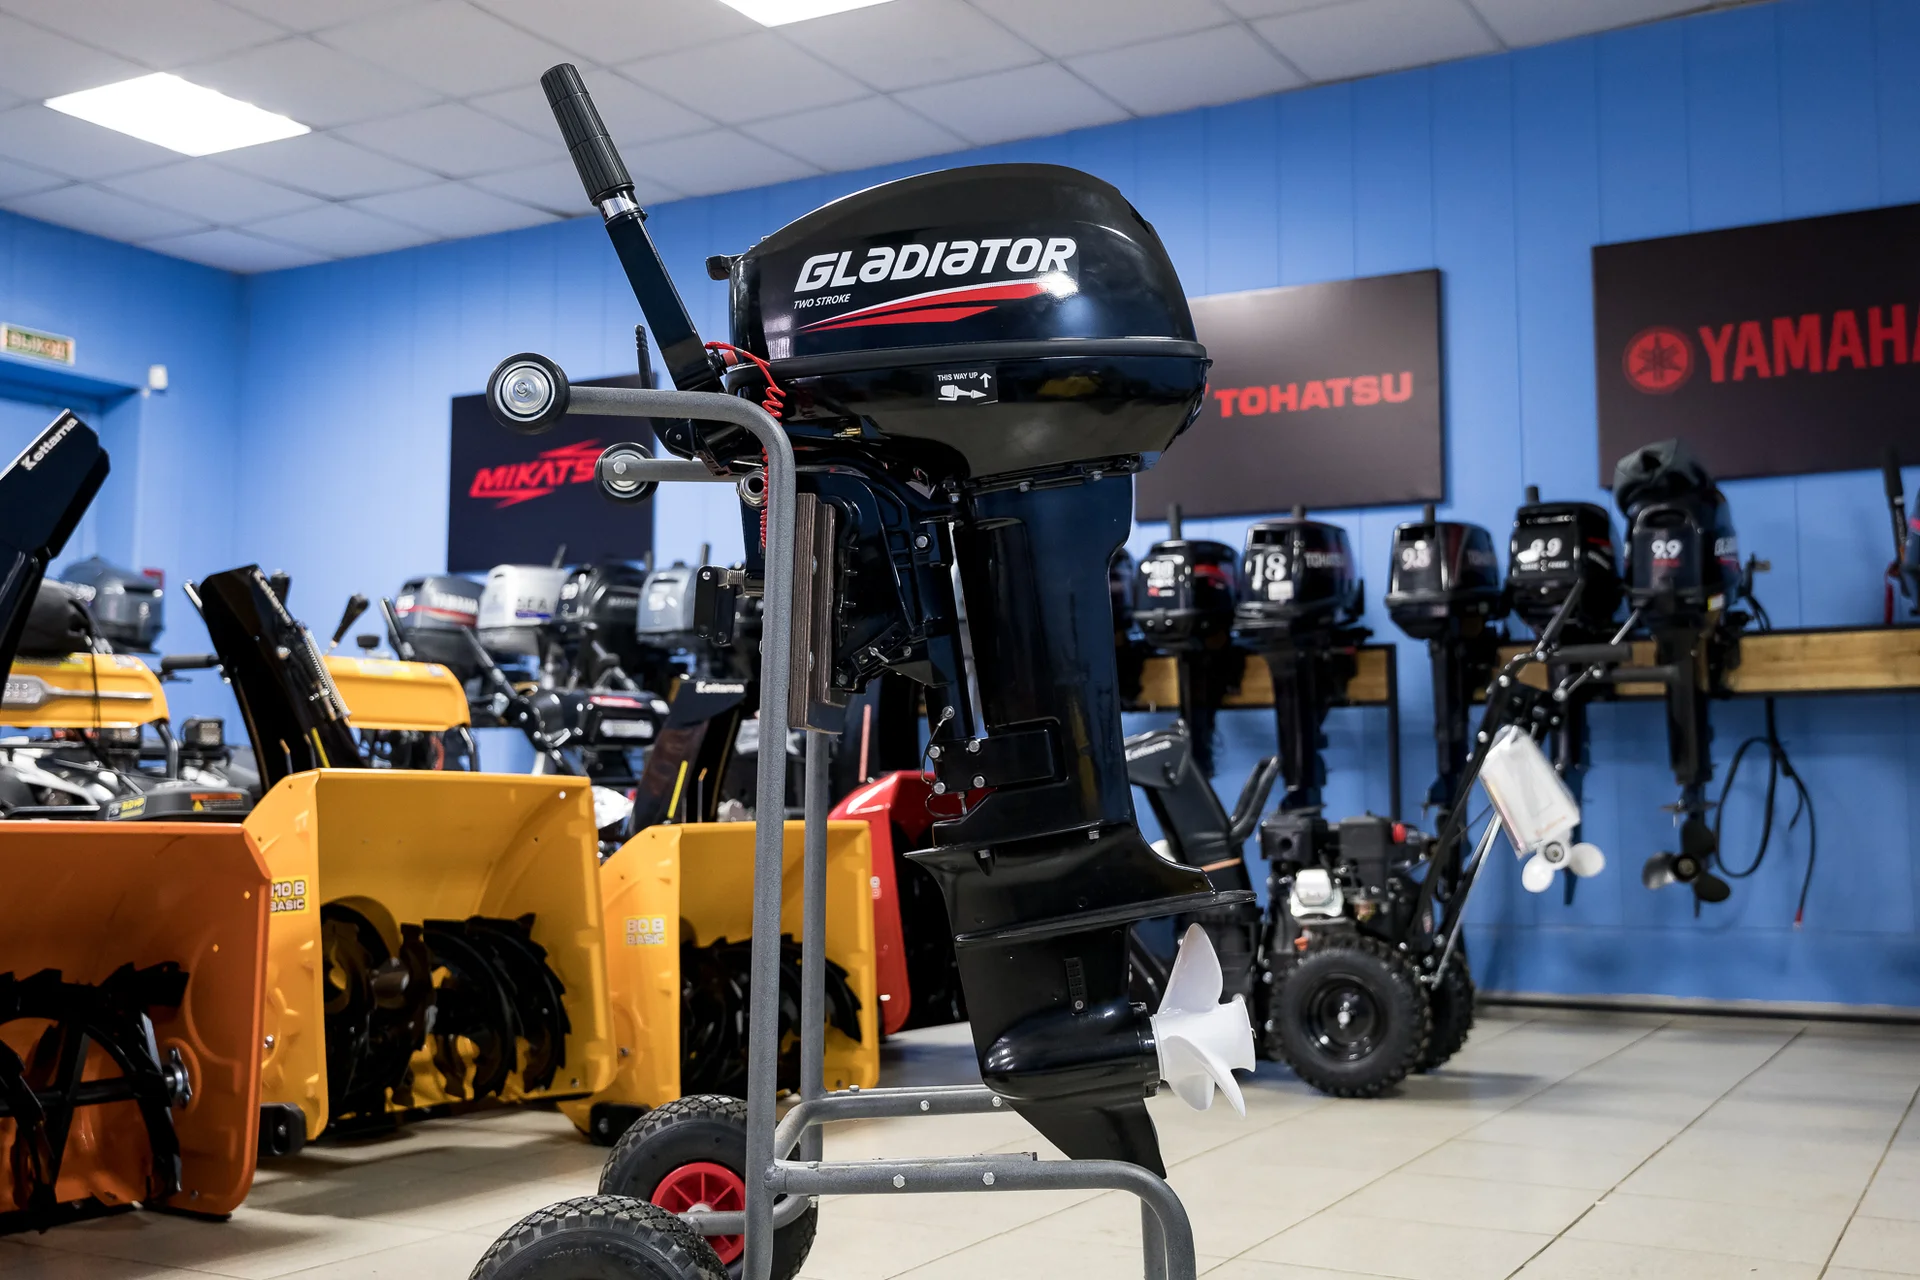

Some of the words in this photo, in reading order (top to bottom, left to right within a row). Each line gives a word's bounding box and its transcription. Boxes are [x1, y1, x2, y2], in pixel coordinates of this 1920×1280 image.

[794, 298, 814, 310] TWO
[815, 293, 851, 307] STROKE
[1698, 302, 1920, 383] YAMAH
[937, 374, 953, 382] THIS
[953, 372, 968, 380] WAY
[968, 371, 979, 379] UP
[1214, 371, 1413, 418] TOHATSU
[20, 417, 79, 471] Kettama
[469, 449, 600, 499] MIKATS
[1651, 539, 1683, 560] 9.9
[1252, 552, 1287, 590] 18
[294, 880, 306, 896] B
[271, 898, 306, 912] BASIC
[651, 917, 665, 933] B
[627, 933, 665, 945] BASIC
